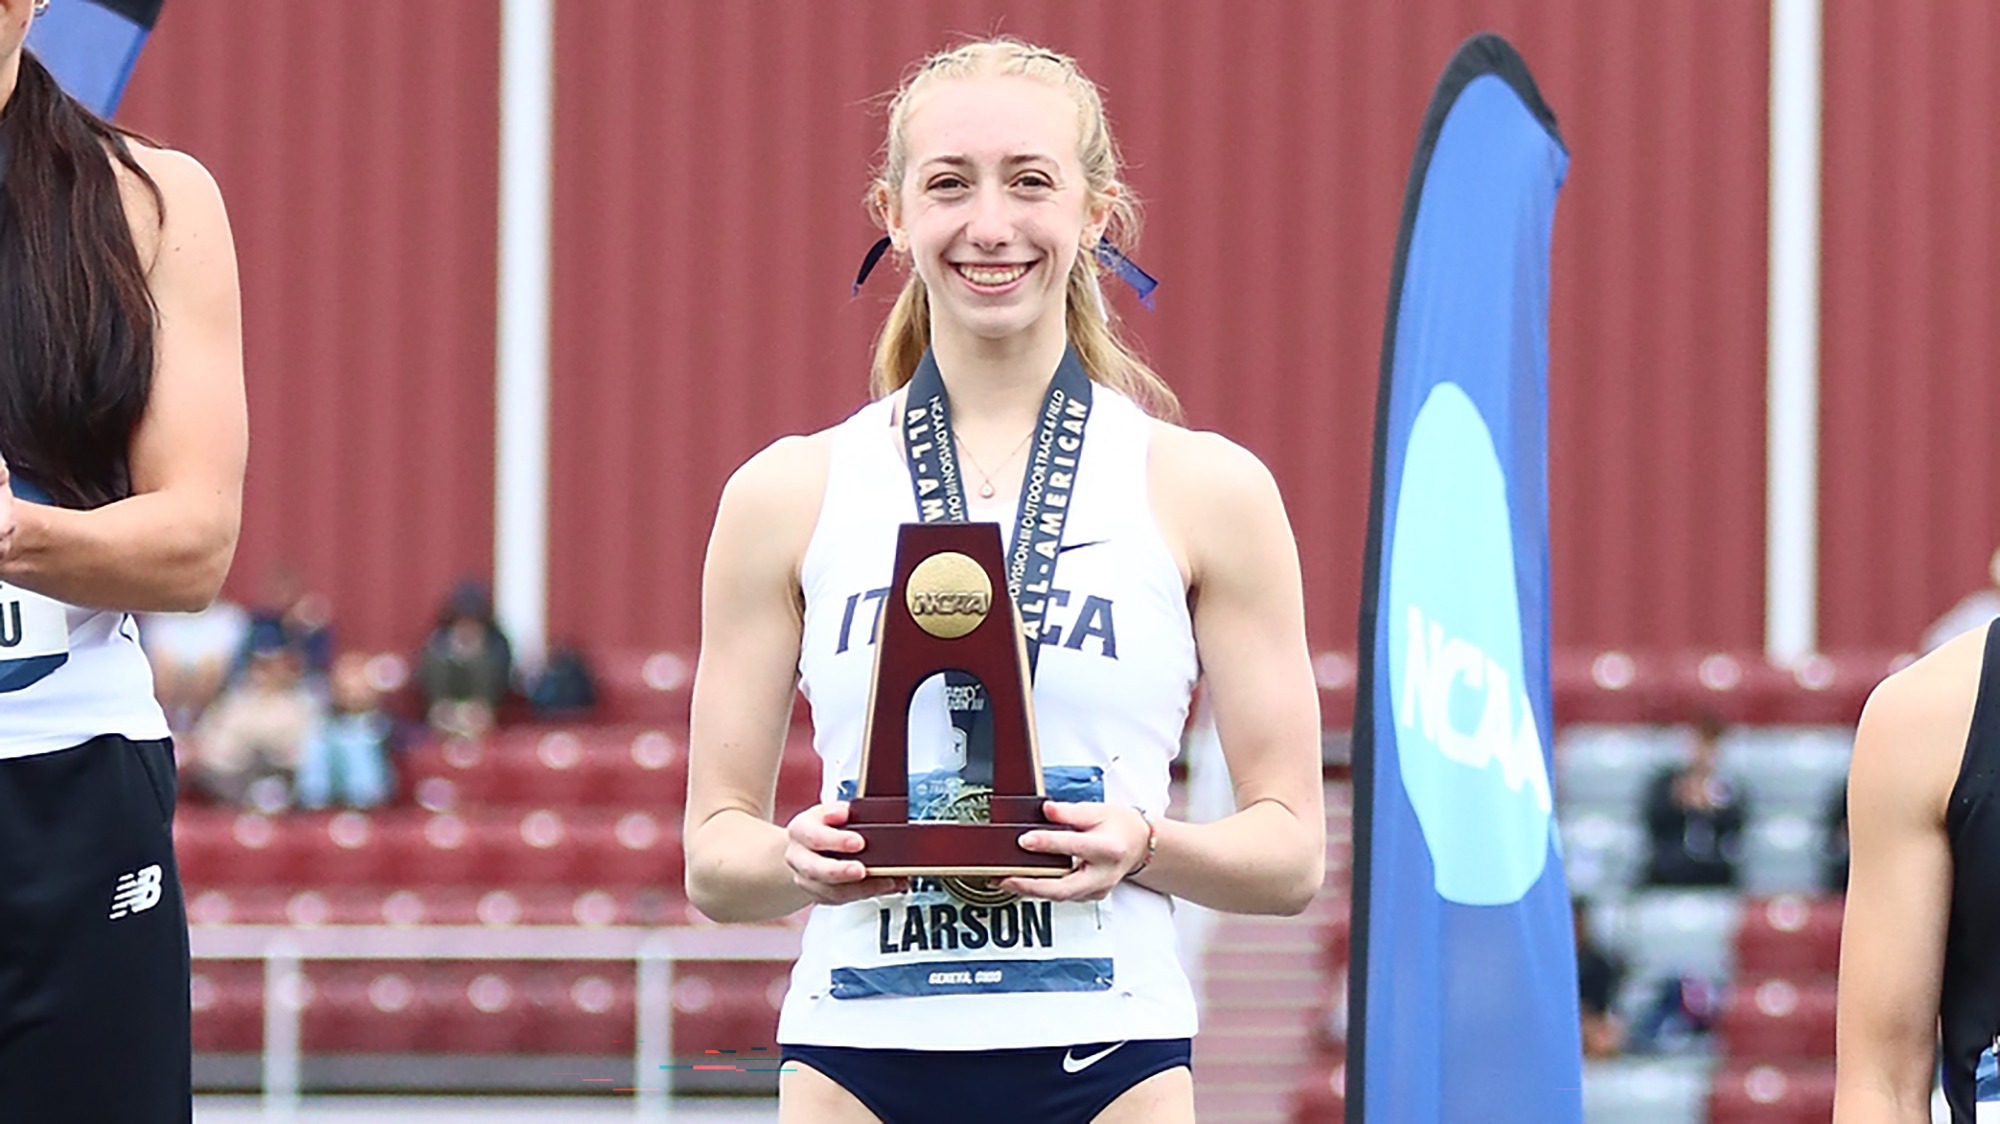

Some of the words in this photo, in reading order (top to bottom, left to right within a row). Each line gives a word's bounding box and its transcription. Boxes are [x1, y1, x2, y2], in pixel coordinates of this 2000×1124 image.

[1018, 398, 1087, 641] ALL-AMERICAN
[1021, 464, 1046, 527] OUTDOOR
[913, 591, 988, 615] NCAA
[1402, 602, 1553, 814] NCAA
[880, 901, 1053, 954] LARSON
